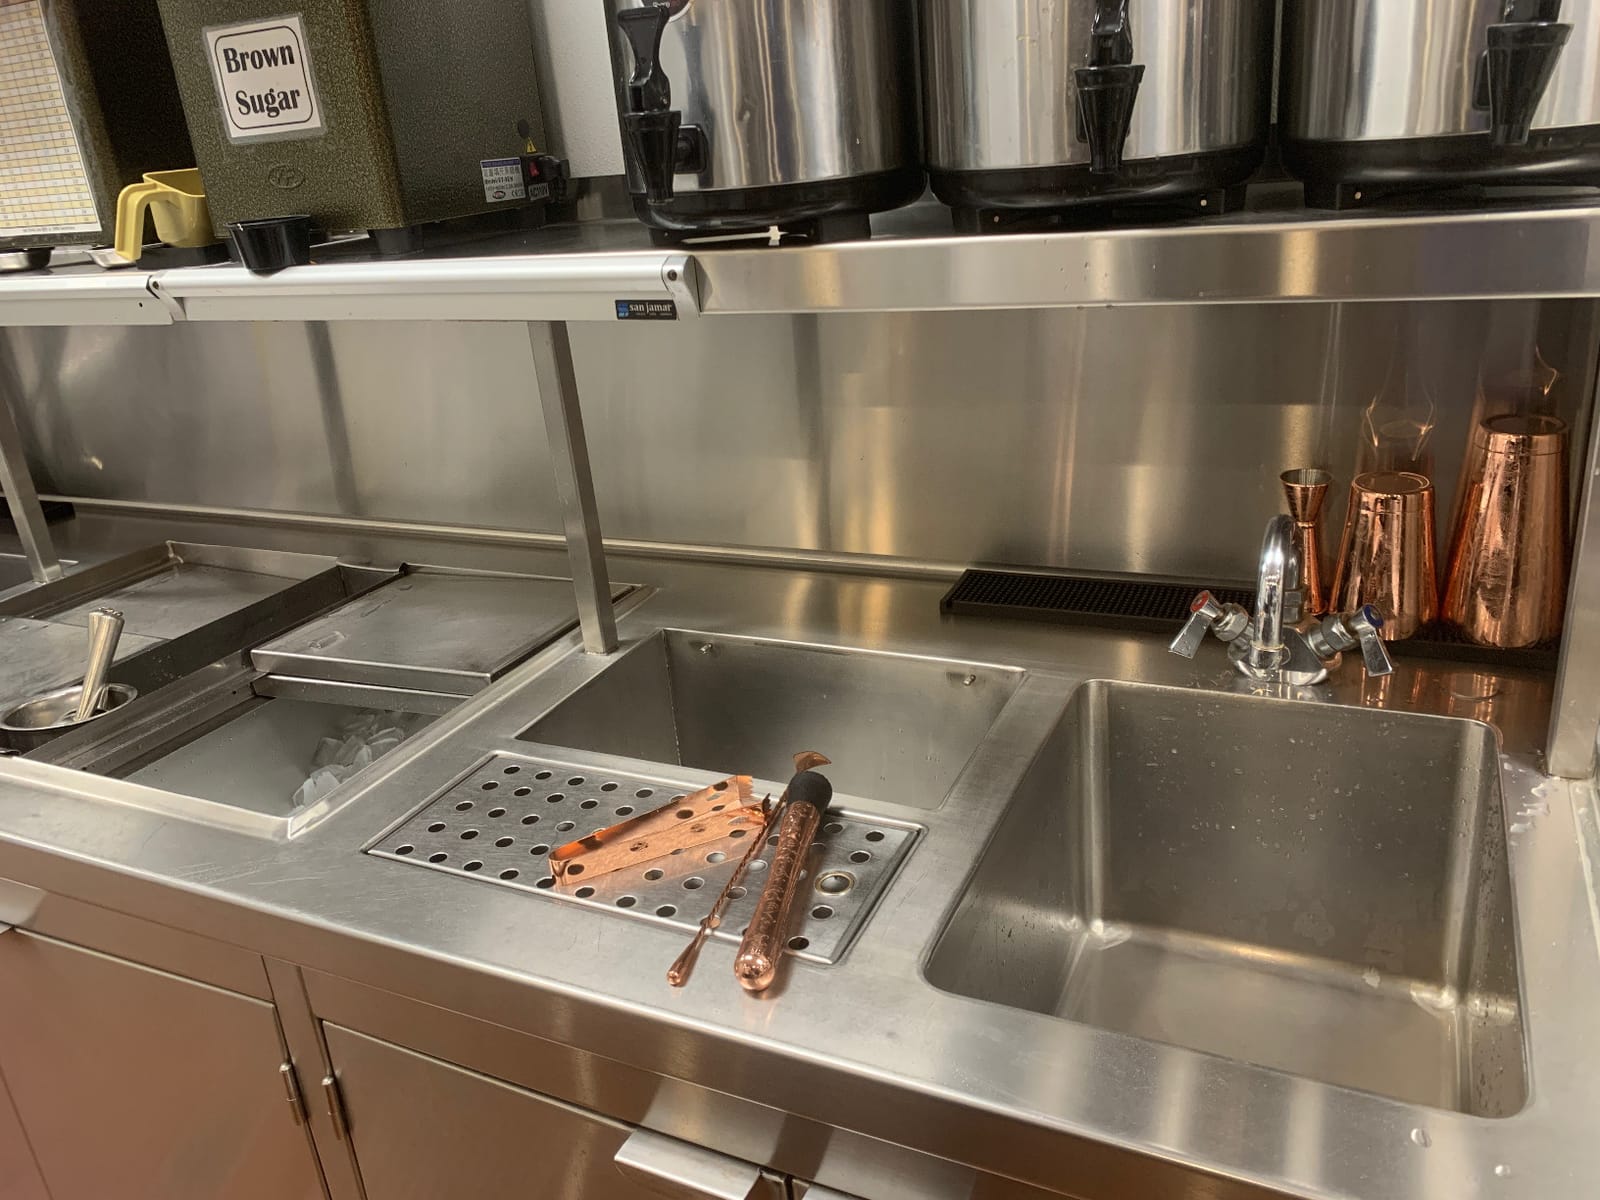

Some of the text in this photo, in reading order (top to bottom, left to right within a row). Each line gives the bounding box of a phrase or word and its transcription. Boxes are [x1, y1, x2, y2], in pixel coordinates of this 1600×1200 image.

[223, 45, 295, 74] Brown
[235, 88, 300, 118] Sugar
[629, 302, 672, 314] san jamar
